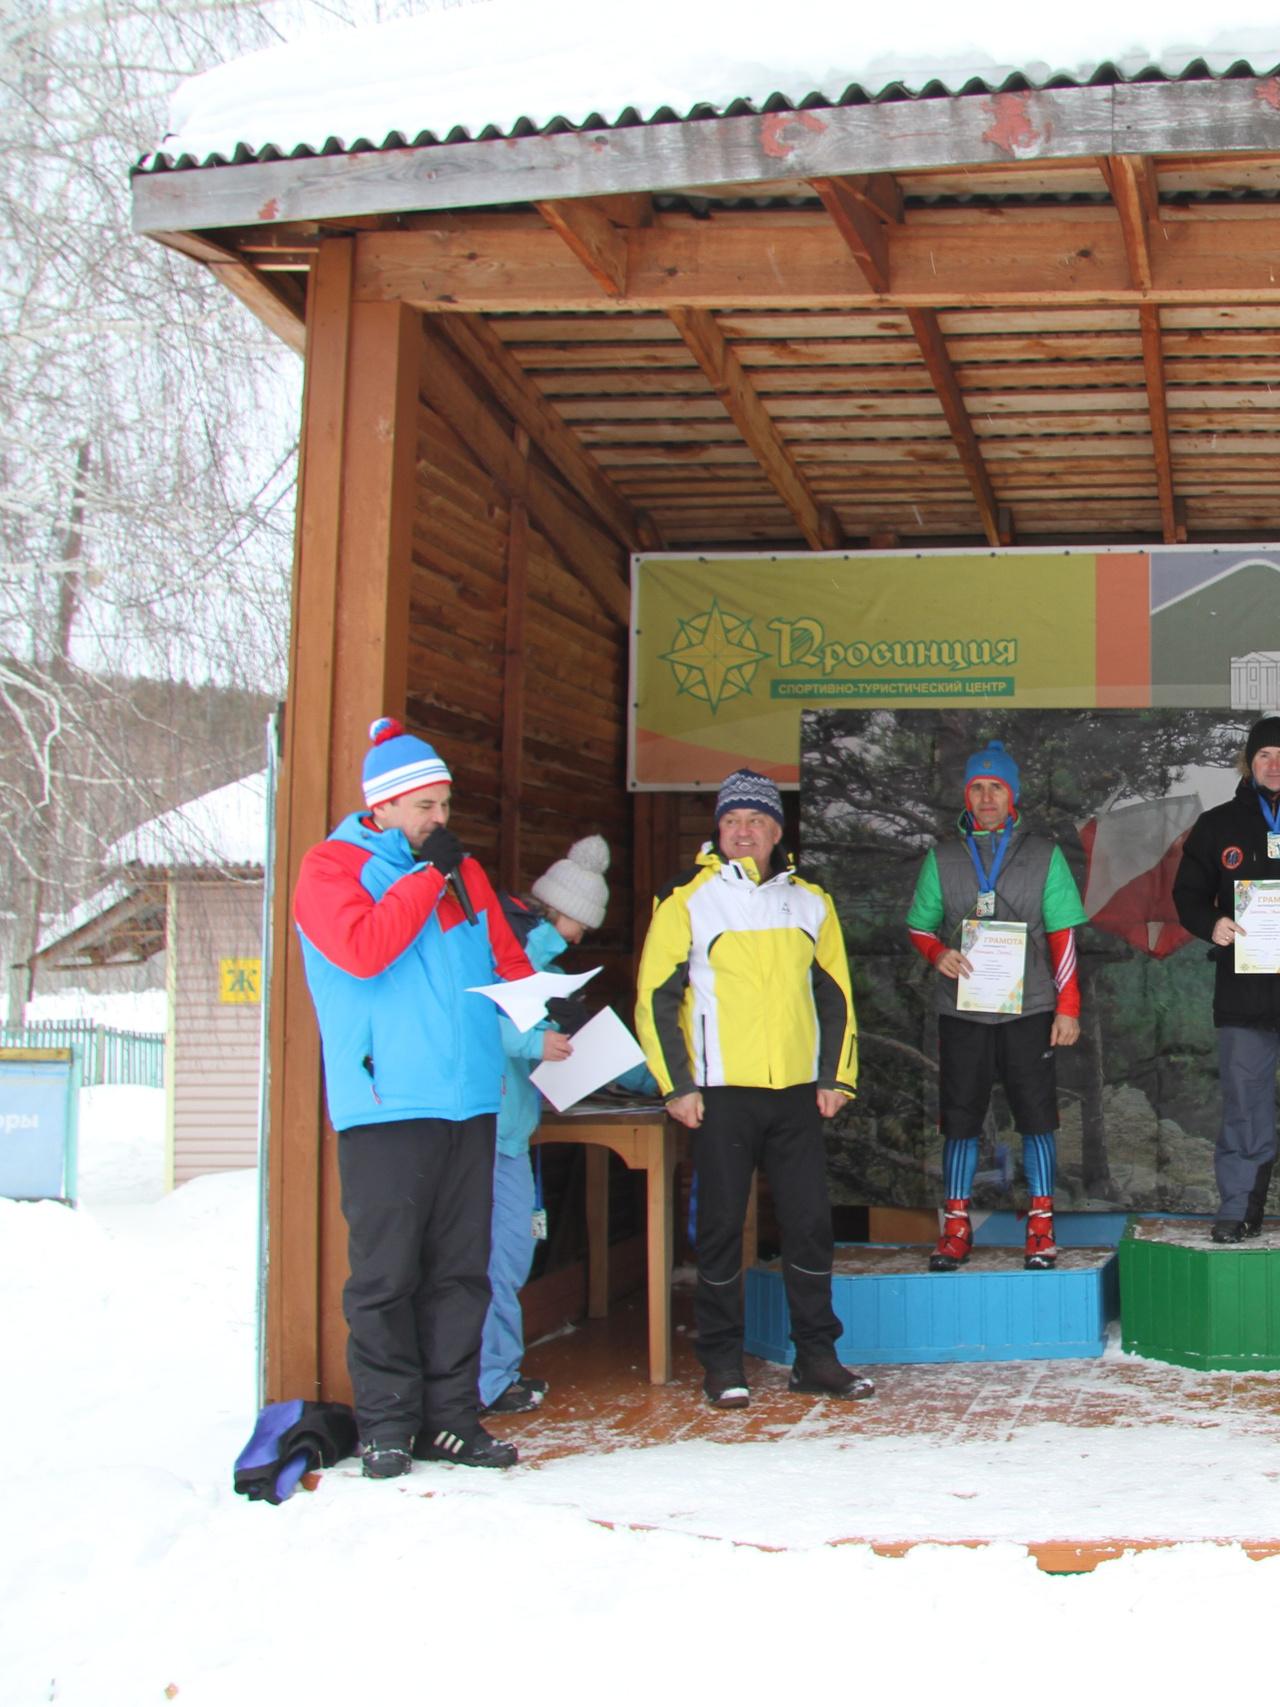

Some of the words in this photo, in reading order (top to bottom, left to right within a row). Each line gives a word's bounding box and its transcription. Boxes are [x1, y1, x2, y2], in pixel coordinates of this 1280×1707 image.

[766, 617, 1018, 676] Провинция
[778, 680, 962, 695] СПОРТИВНО-ТУРИСТИЧЕСКИЙ
[966, 680, 1007, 694] ЦЕНТР
[984, 936, 1023, 945] ГРАМОТА
